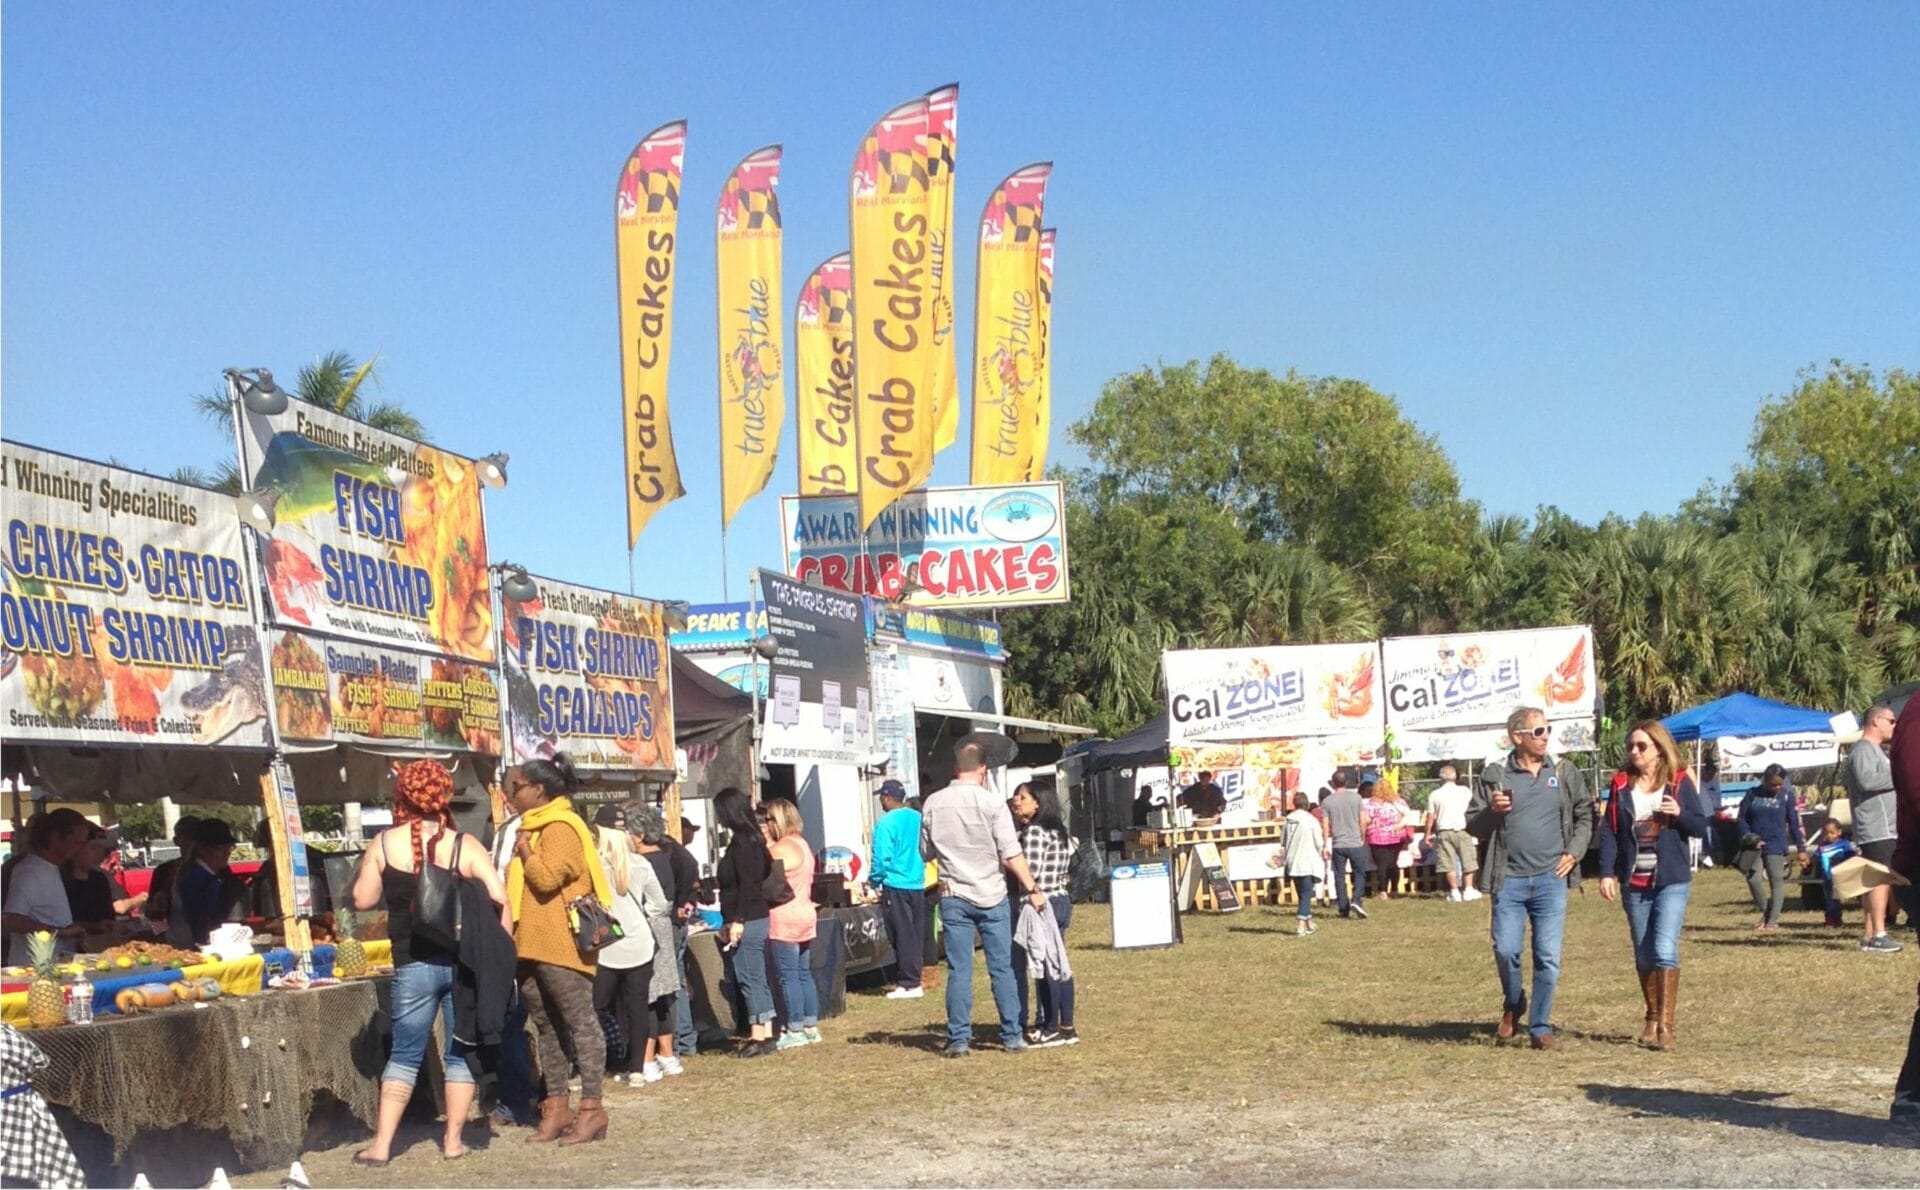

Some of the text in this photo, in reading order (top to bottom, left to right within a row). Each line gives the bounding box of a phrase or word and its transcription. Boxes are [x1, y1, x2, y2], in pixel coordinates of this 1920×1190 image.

[633, 229, 674, 504] Crab Cakes
[735, 278, 770, 457] true blue
[866, 211, 927, 489] Crab Cakes
[989, 288, 1033, 458] true blue
[815, 336, 854, 449] Cakes
[297, 411, 435, 480] Famous Fried Platters
[15, 457, 93, 514] Winning
[99, 478, 198, 527] Specialities
[334, 468, 407, 547] FISH
[793, 505, 978, 545] AWAR WINNING
[320, 543, 434, 623] SHRIMP
[540, 586, 570, 610] Fresh
[571, 592, 601, 619] Grilled
[795, 543, 1060, 600] CRAB CAKES
[103, 606, 228, 671] SHRIMP
[327, 645, 419, 686] Sampler Platter
[274, 667, 327, 691] JAMBALAYA
[348, 681, 373, 706] FISH
[383, 685, 422, 712] SHRIMP
[538, 682, 655, 741] SCALLOPS
[10, 708, 48, 728] Served
[74, 713, 124, 732] Seasoned
[160, 717, 202, 736] Coleslaw
